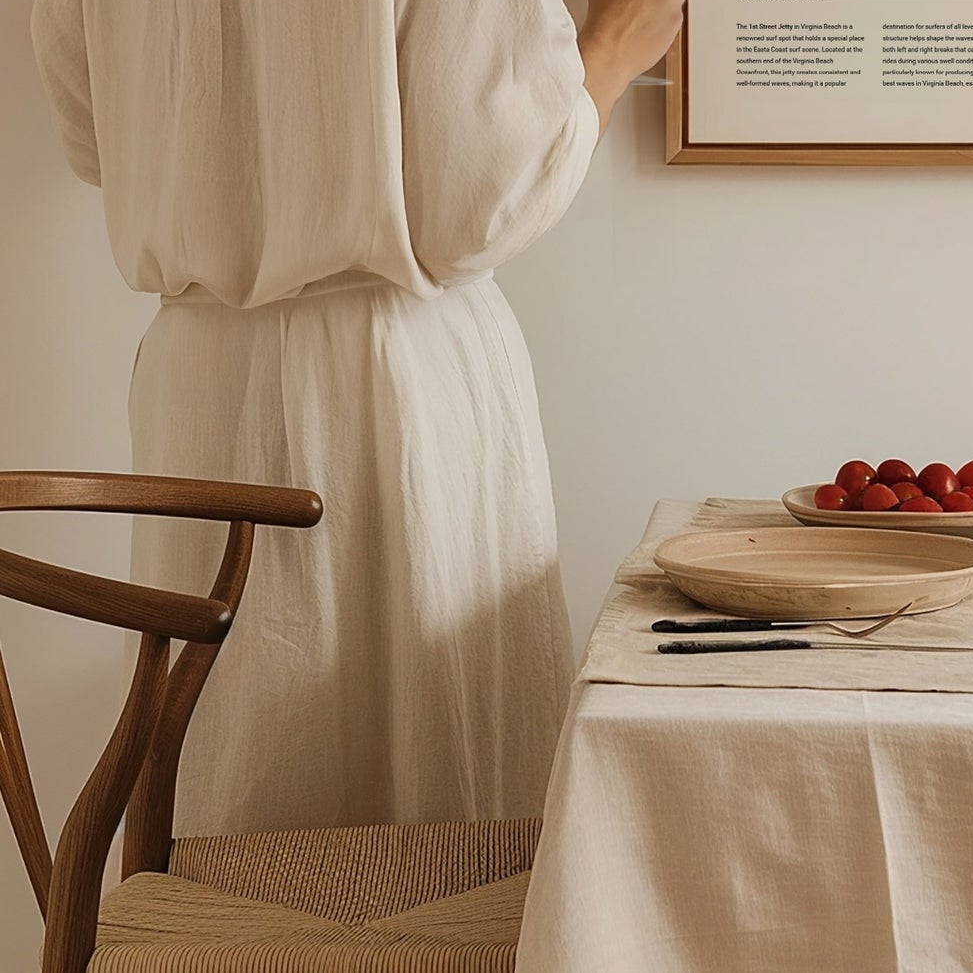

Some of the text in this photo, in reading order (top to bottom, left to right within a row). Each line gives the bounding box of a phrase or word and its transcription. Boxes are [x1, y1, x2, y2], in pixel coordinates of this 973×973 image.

[778, 23, 793, 31] Jetty
[800, 23, 823, 31] Virginia
[909, 35, 926, 43] helps
[919, 46, 933, 54] right
[792, 57, 815, 65] Virginia
[898, 58, 916, 66] during
[922, 80, 944, 88] Virginia
